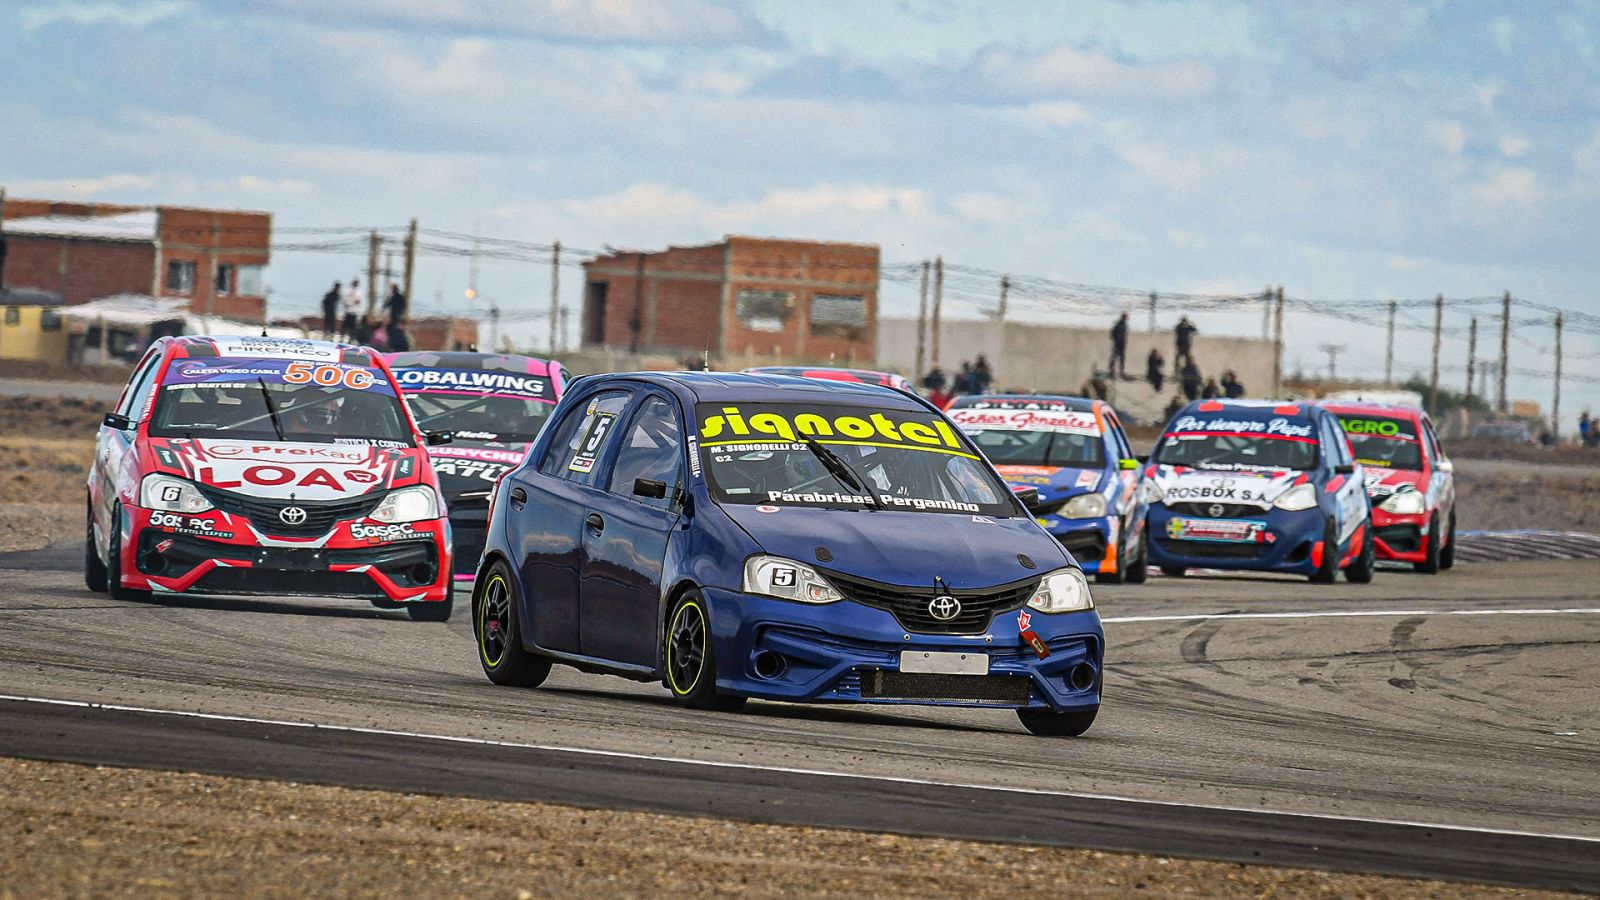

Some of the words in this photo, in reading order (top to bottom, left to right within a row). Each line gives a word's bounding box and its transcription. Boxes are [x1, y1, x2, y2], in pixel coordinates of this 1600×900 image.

[396, 370, 544, 393] LOBALWING
[587, 417, 611, 452] 5
[251, 446, 362, 460] PreKad
[710, 446, 725, 454] M.
[726, 443, 790, 453] SIGNORELLI
[200, 465, 345, 492] LOA
[163, 487, 180, 501] 6
[768, 490, 875, 504] Parabrisas
[879, 494, 980, 512] Pergamino
[1166, 487, 1236, 499] ROSBOX
[774, 568, 793, 586] 5
